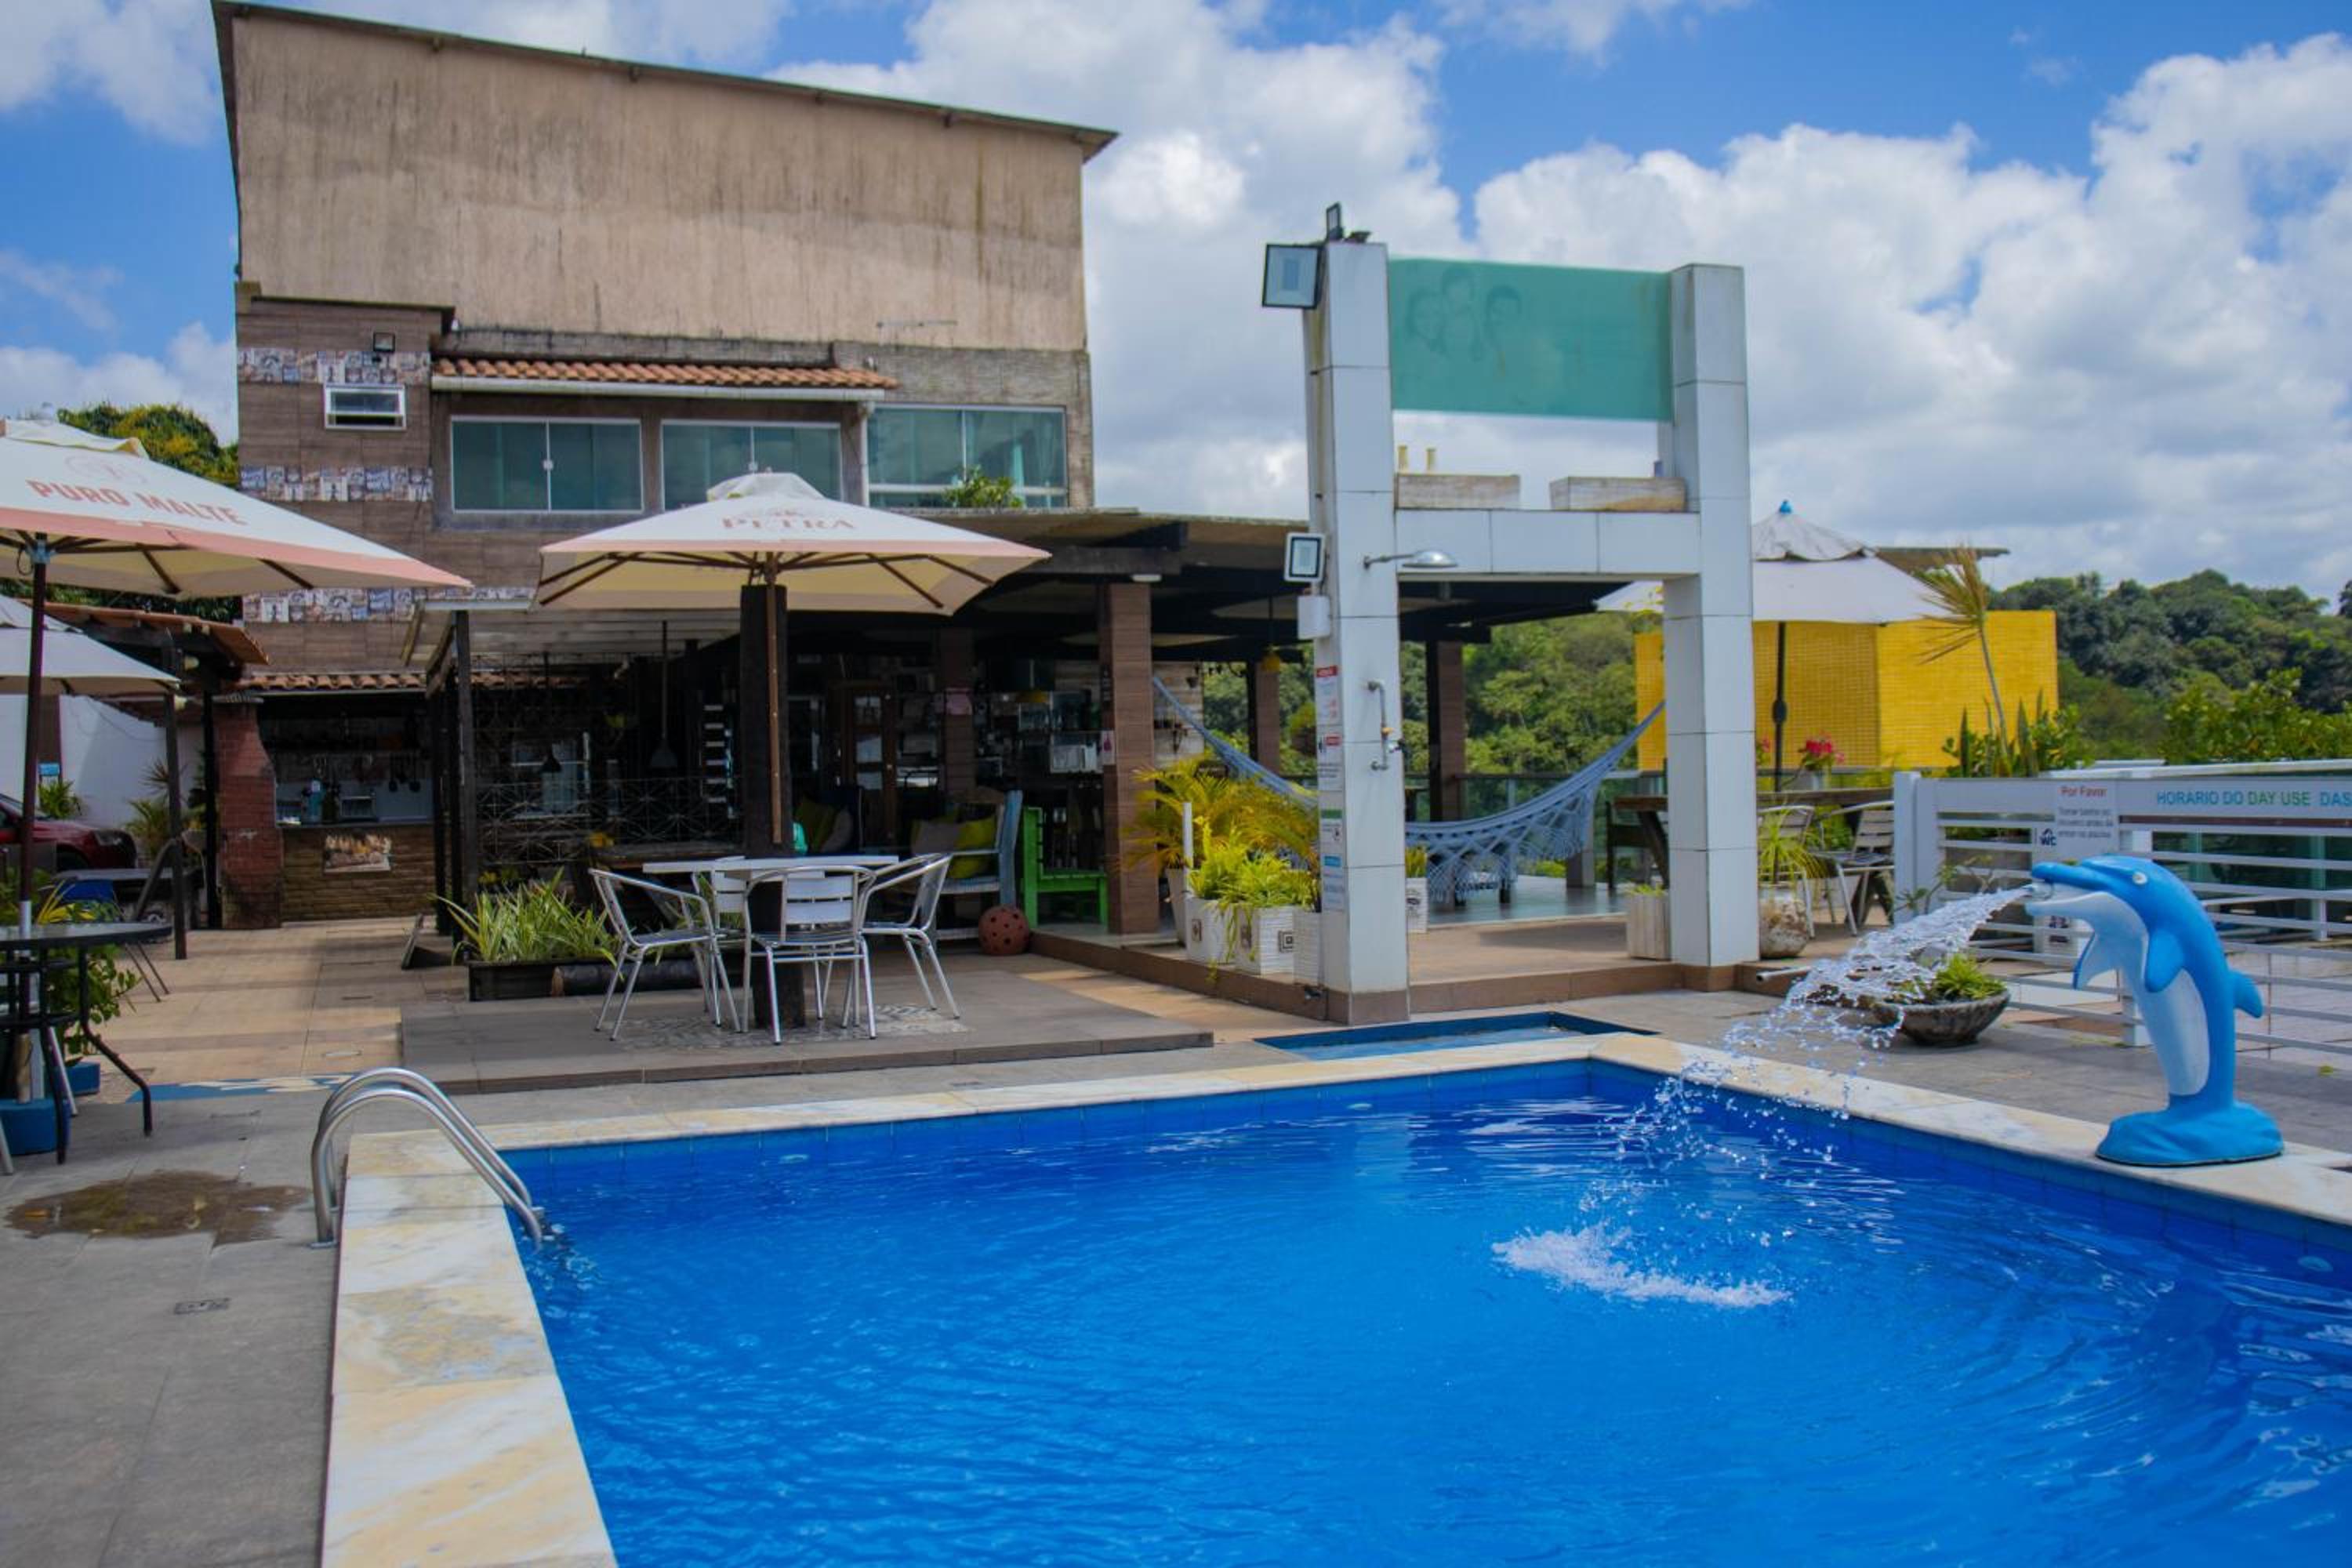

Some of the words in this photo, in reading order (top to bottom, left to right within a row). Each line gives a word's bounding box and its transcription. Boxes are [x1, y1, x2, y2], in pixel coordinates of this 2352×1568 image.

[25, 478, 131, 507] PURO
[132, 491, 249, 526] MALTE
[721, 517, 855, 531] PETRA
[2060, 786, 2078, 797] Por
[2080, 786, 2107, 797] Favor
[2222, 790, 2245, 806] DO
[2247, 790, 2274, 806] DAY
[2280, 790, 2311, 807] USE
[2320, 790, 2352, 808] DAS
[2039, 836, 2057, 846] WC
